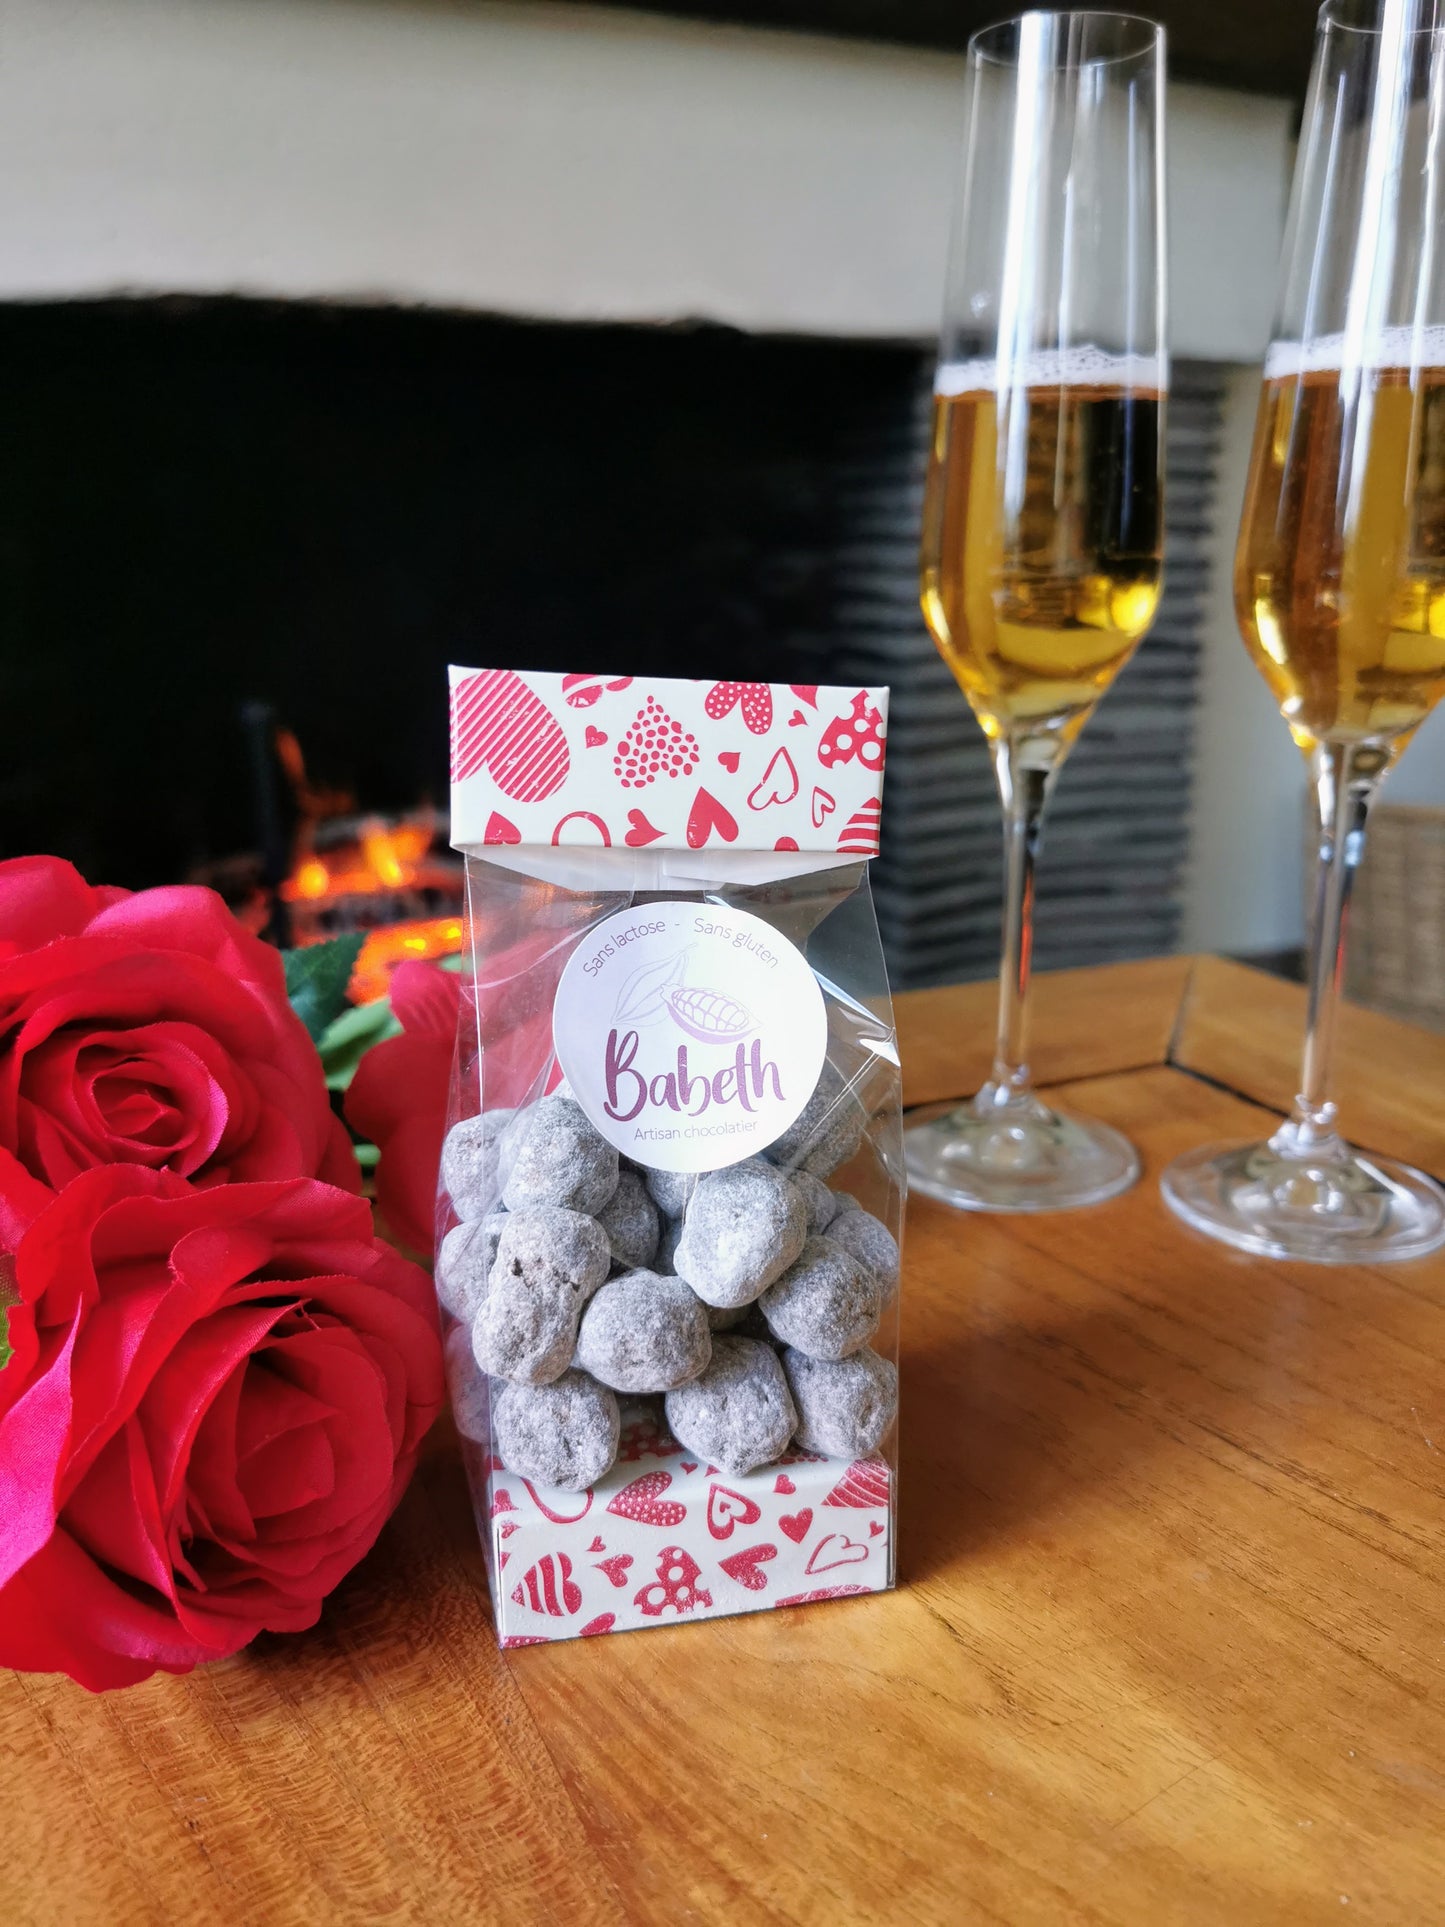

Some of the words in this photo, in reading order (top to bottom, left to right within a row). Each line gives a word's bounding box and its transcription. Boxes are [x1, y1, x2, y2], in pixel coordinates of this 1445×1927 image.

[583, 947, 615, 977] Sans
[611, 920, 666, 948] lactose
[694, 917, 731, 940] Sans
[732, 932, 779, 969] gluten
[603, 1028, 787, 1122] Babeth
[634, 1126, 681, 1141] Artisan
[684, 1120, 758, 1139] chocolatier
